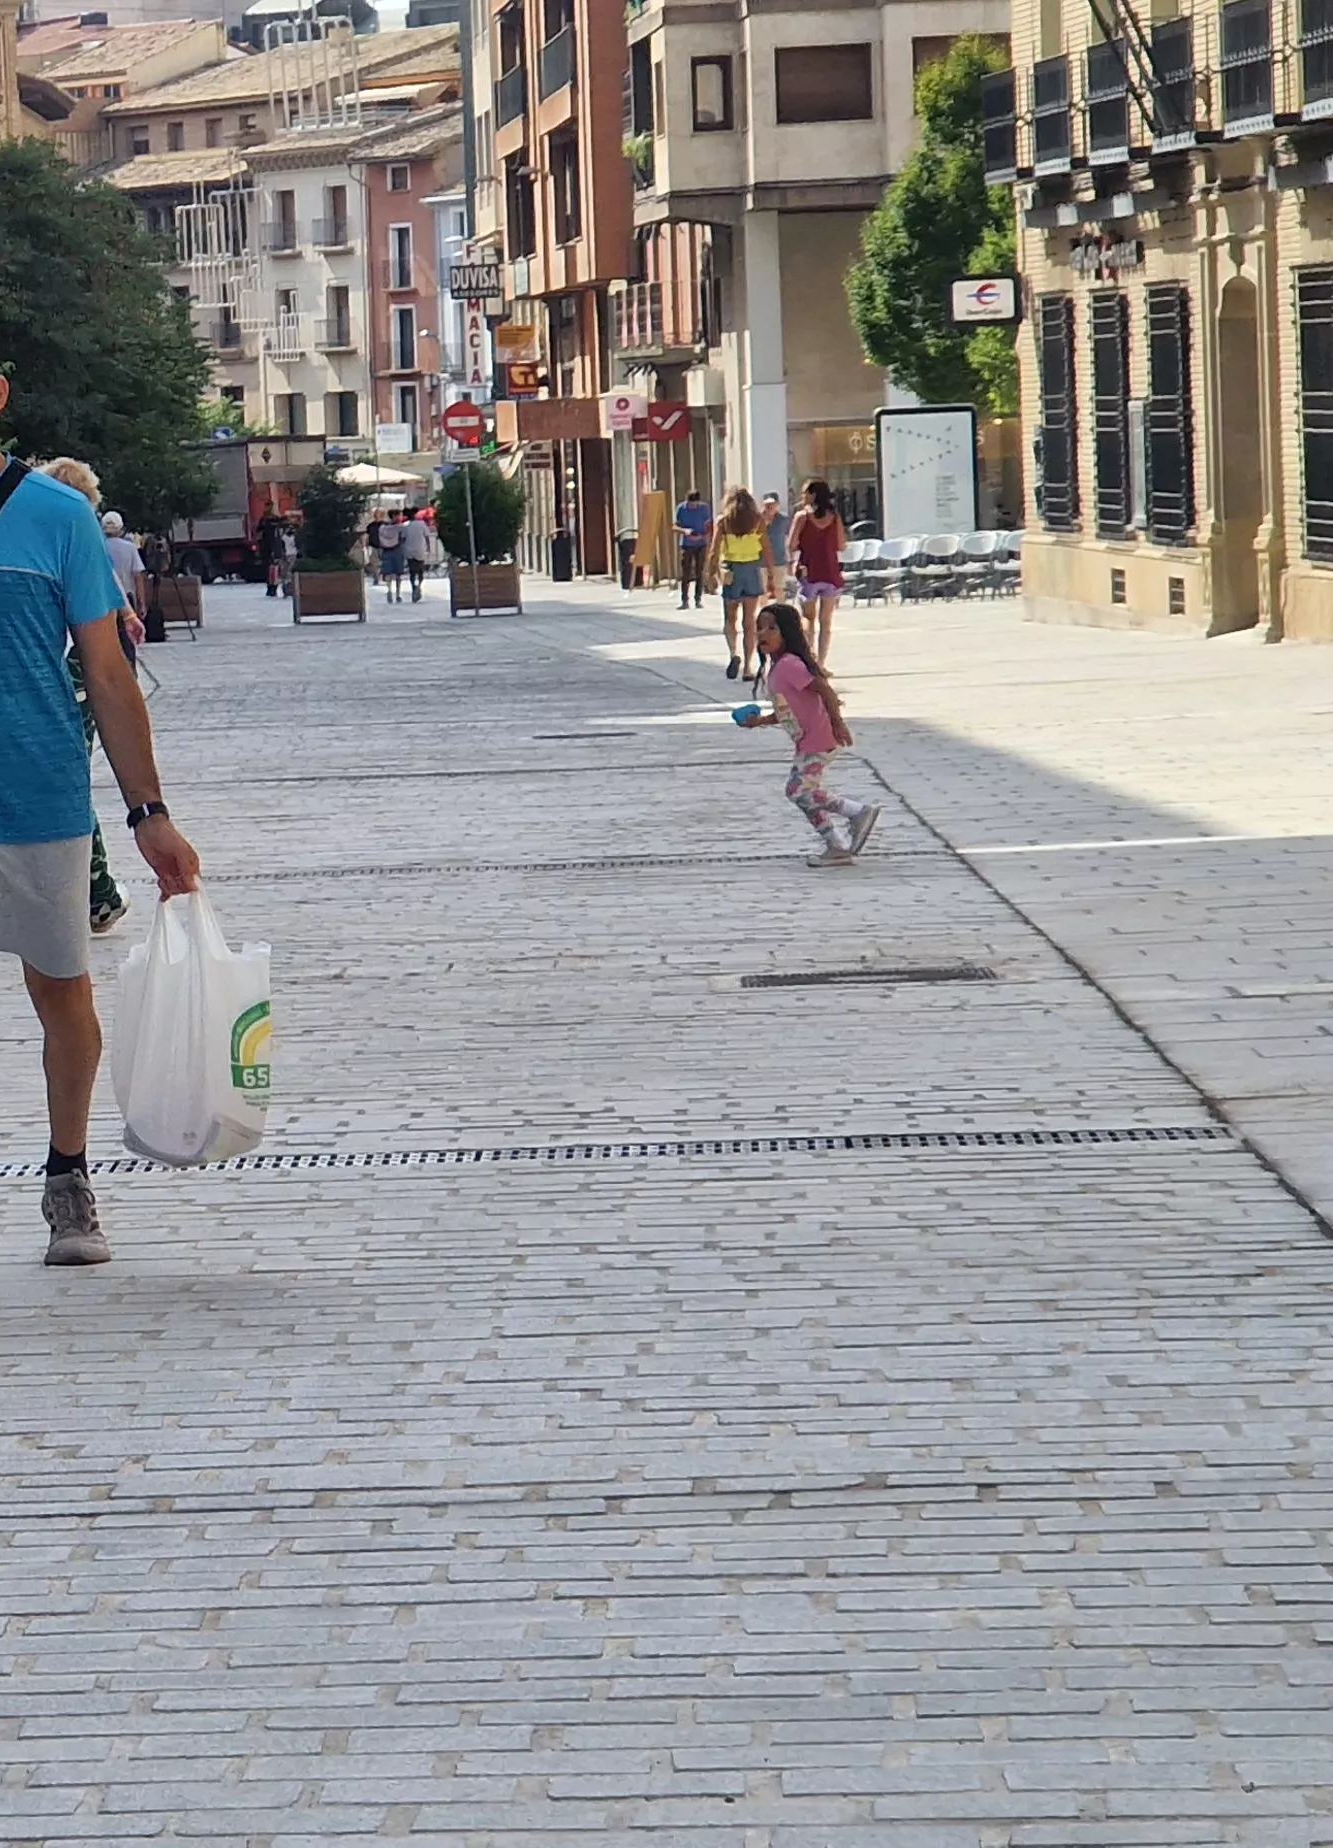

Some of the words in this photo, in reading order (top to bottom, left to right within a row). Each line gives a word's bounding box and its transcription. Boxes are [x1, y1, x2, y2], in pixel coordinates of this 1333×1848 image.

[451, 266, 498, 290] DUVISA
[464, 244, 482, 385] FMACIA
[243, 1067, 268, 1088] 65
